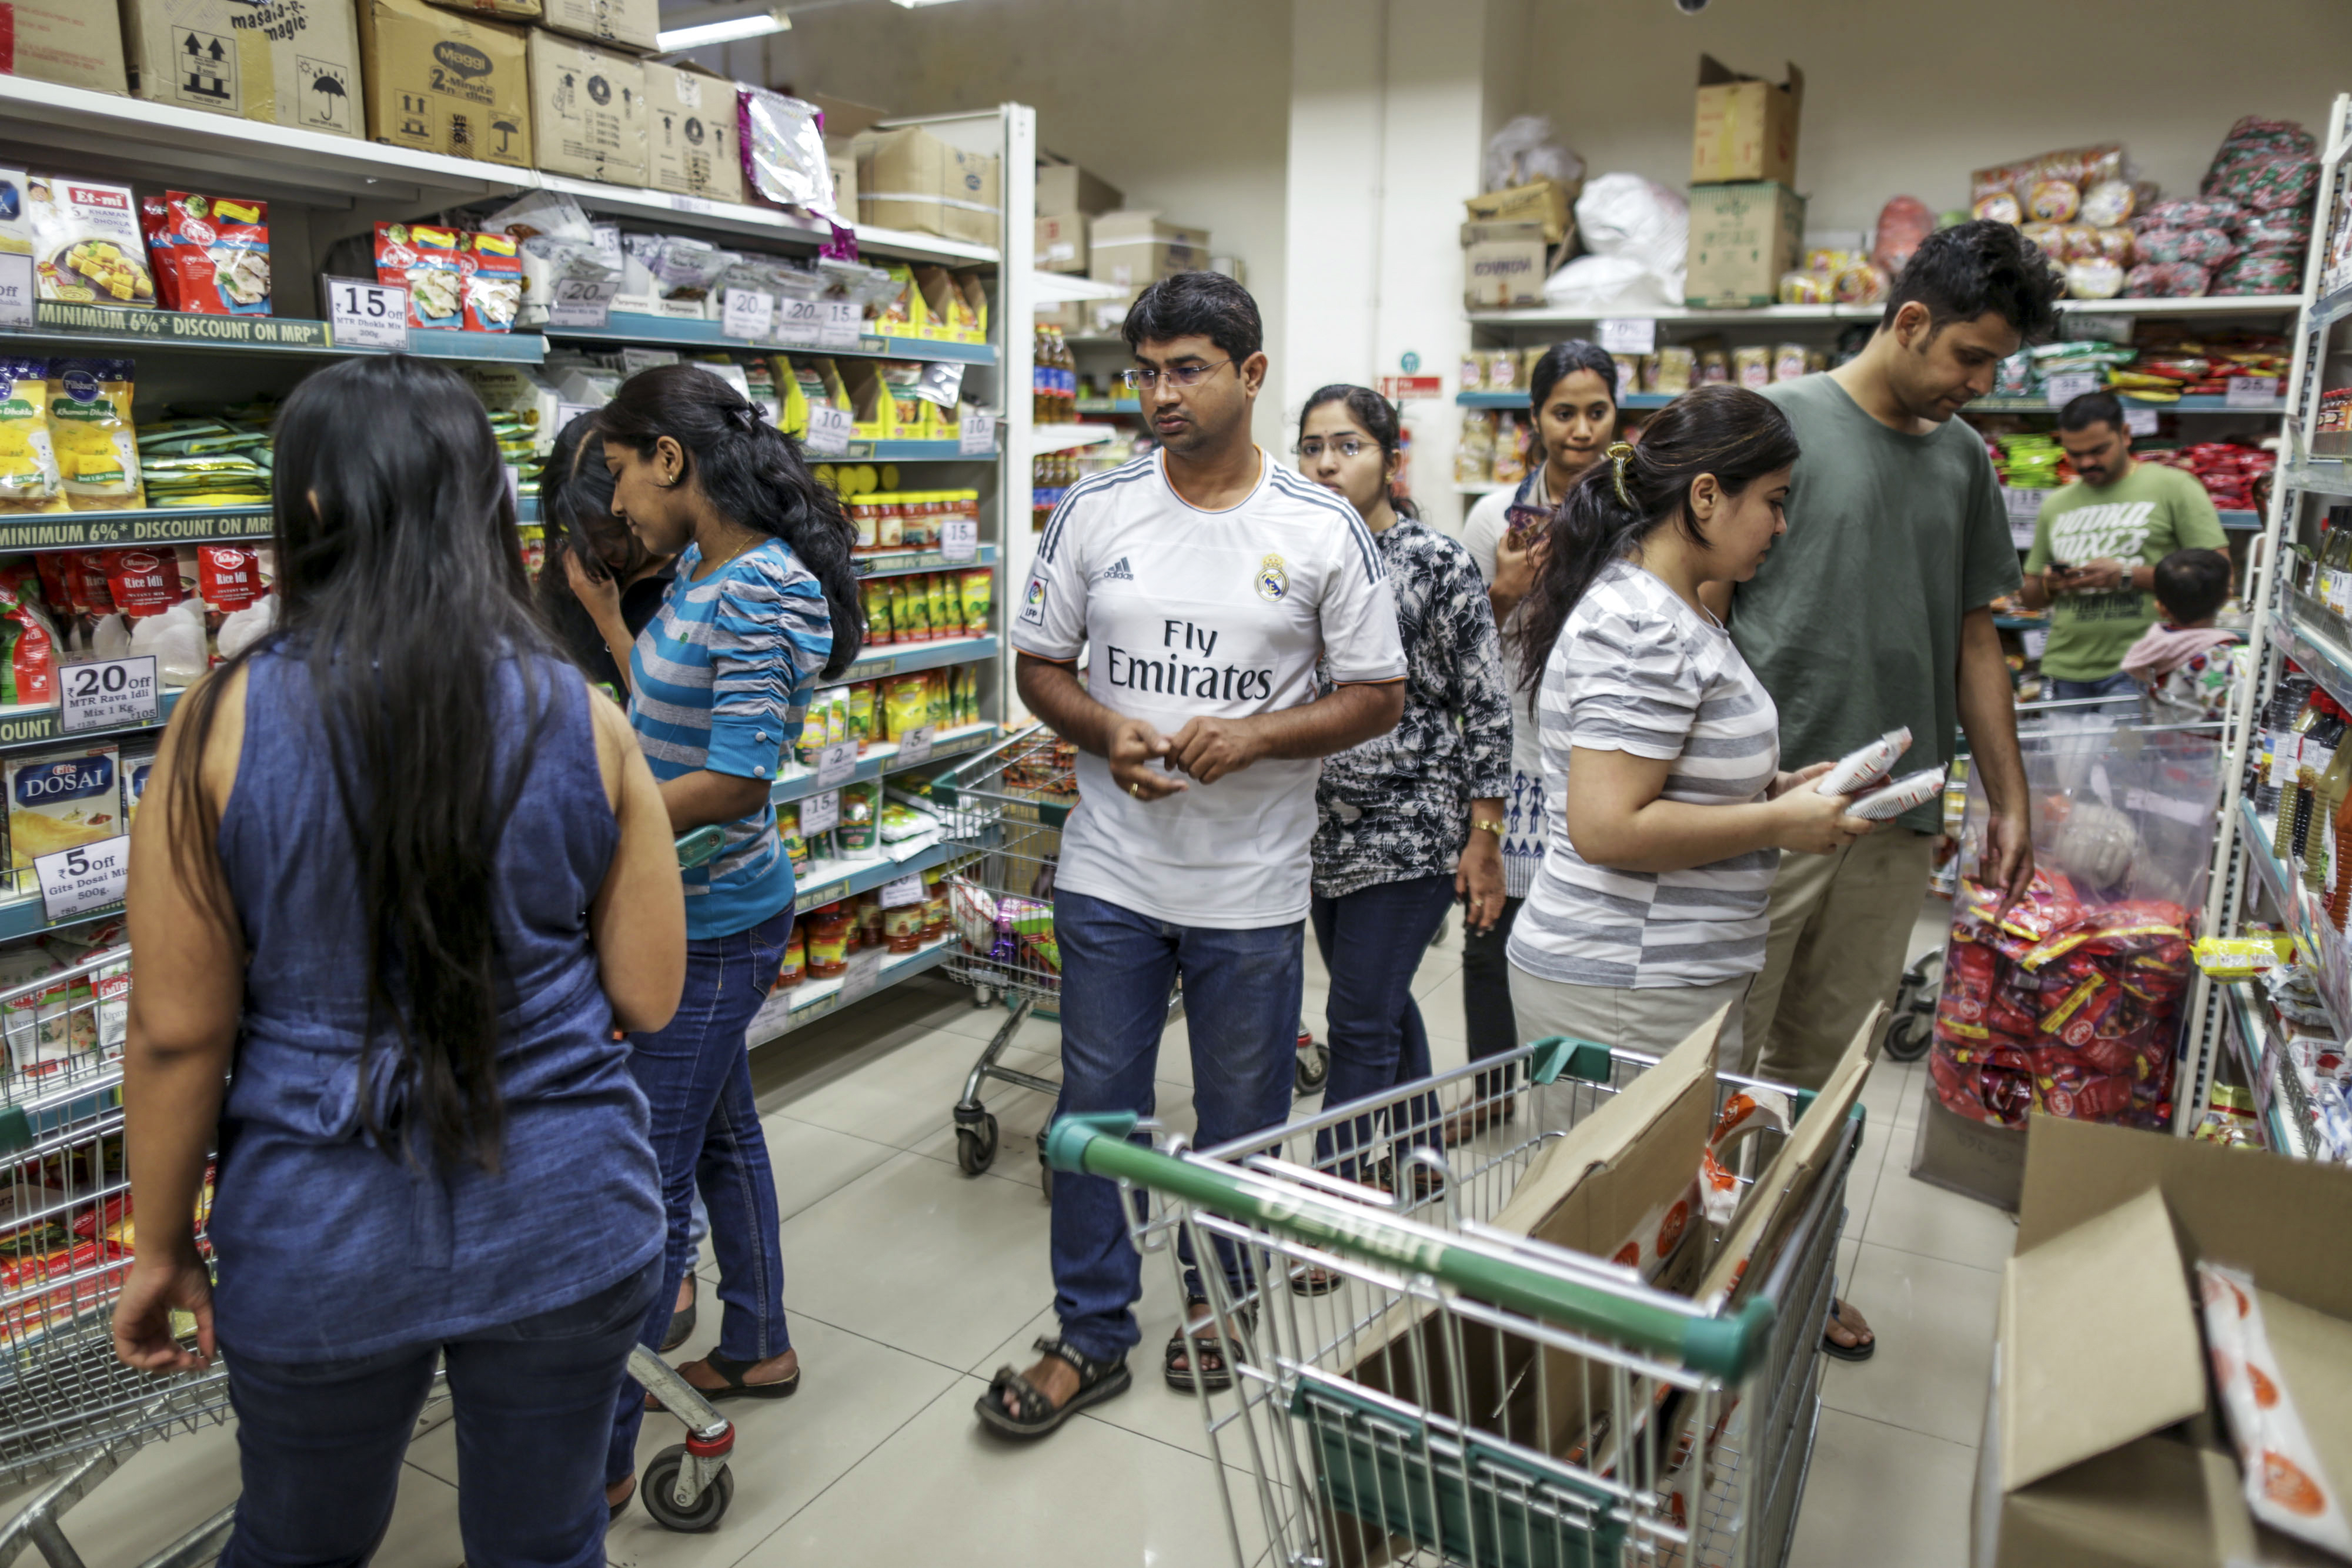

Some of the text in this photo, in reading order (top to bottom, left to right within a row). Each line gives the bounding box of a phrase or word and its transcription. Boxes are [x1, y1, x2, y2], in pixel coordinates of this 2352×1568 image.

[263, 16, 306, 41] magic
[440, 47, 486, 70] Maggi
[74, 190, 123, 207] Et-mi
[89, 209, 129, 218] KHAMAN
[93, 218, 131, 227] DHOKLA
[387, 310, 404, 320] Off
[38, 304, 125, 330] MINIMUM
[173, 317, 250, 340] DISCOUNT
[255, 323, 277, 341] ON
[336, 317, 355, 325] MTR
[358, 319, 385, 328] Dhokla
[65, 380, 97, 392] Pillsbury
[56, 407, 88, 416] Khaman
[0, 524, 84, 546] MINIMUM
[134, 519, 214, 539] DISCOUNT
[219, 518, 241, 535] ON
[216, 572, 247, 585] Rice Idli
[1104, 570, 1134, 581] adidas
[124, 576, 163, 589] Rice Idli
[1025, 608, 1037, 618] LFP
[1164, 620, 1218, 657] Fly
[1107, 645, 1273, 701] Emirates
[128, 676, 152, 689] Off
[69, 690, 149, 708] MTR Rava Idli
[83, 708, 104, 718] Mix
[52, 764, 77, 775] Gits
[25, 770, 103, 797] DOSAI
[92, 856, 115, 871] Off
[49, 883, 73, 895] Gits
[76, 872, 109, 888] Dosai
[103, 1009, 127, 1021] Upm
[49, 1251, 95, 1274] Palak aneer
